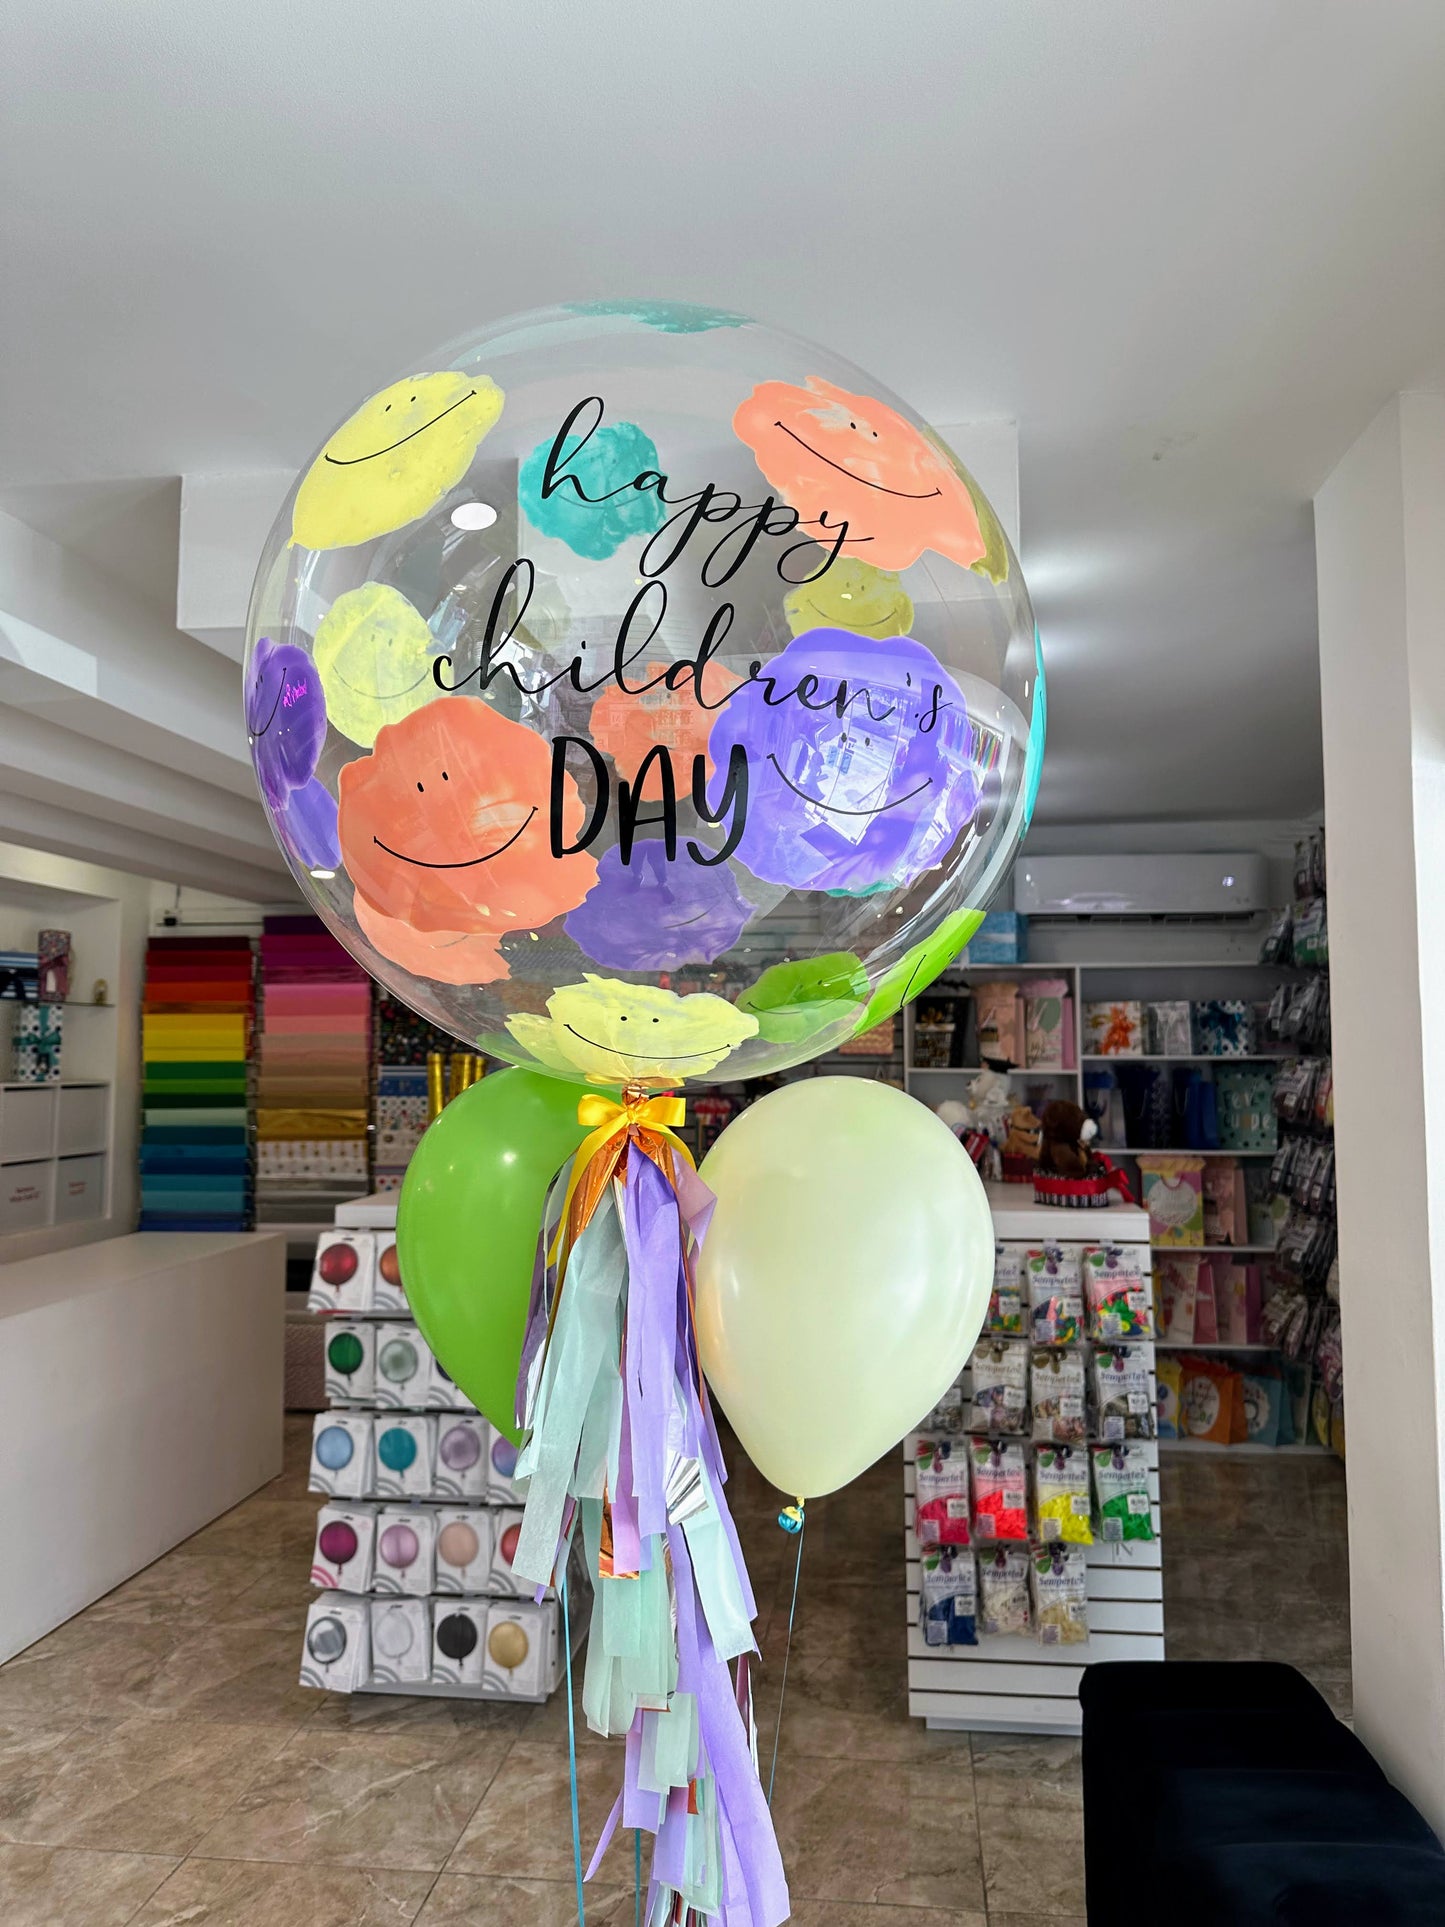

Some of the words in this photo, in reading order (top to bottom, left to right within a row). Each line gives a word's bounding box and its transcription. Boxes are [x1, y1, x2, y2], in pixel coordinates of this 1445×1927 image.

[541, 396, 875, 587] happy
[432, 557, 954, 733] children's
[549, 735, 751, 867] DAY
